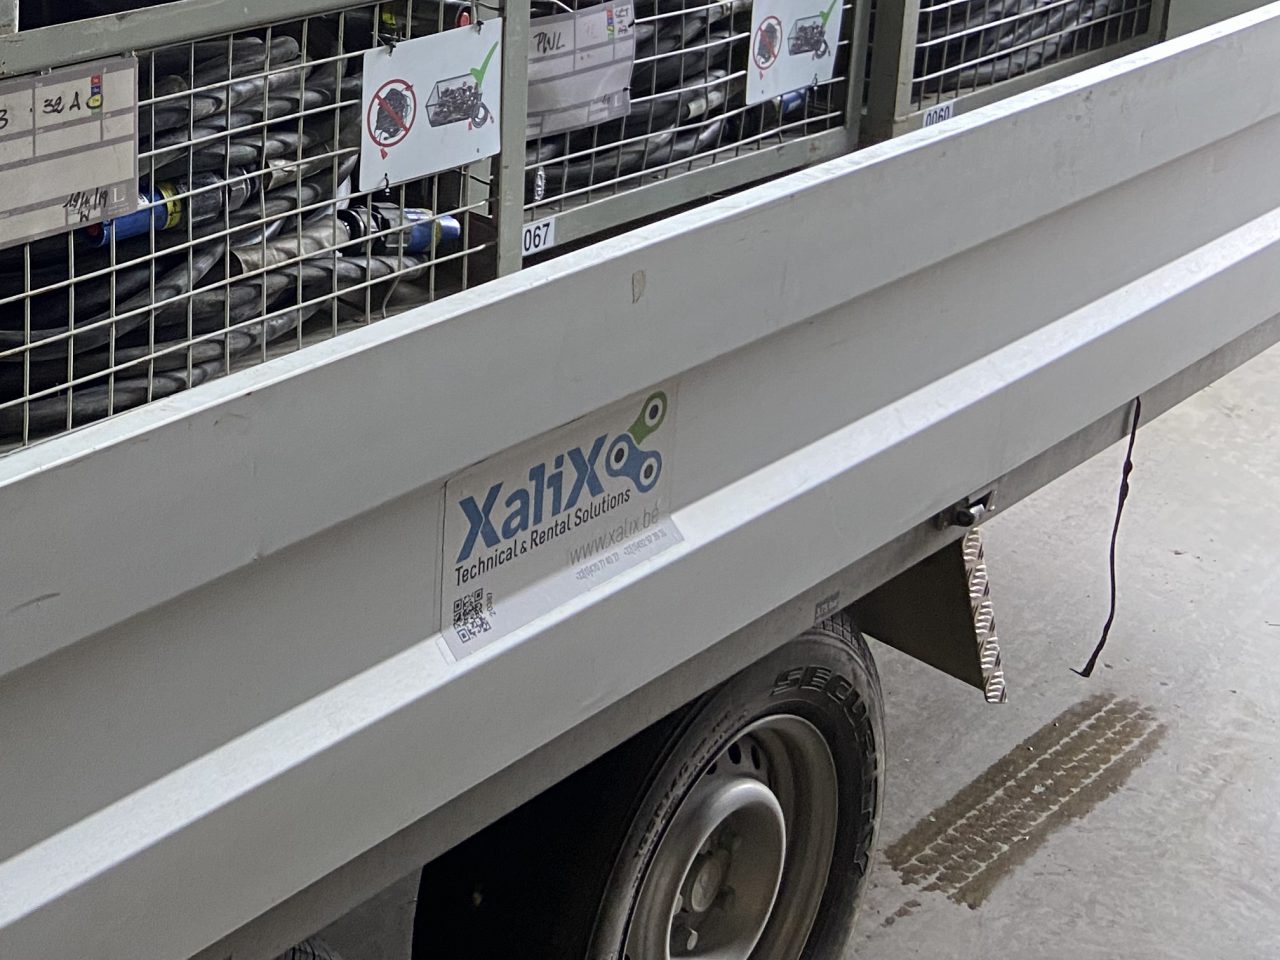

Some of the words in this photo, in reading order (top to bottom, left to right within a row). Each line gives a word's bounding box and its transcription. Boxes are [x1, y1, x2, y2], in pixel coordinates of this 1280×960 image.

[42, 95, 66, 114] 32
[69, 91, 81, 112] A
[925, 105, 950, 127] 0060
[455, 540, 518, 586] Technical
[520, 541, 528, 554] &
[529, 514, 571, 548] Rental
[574, 488, 631, 527] Solutions
[569, 504, 660, 566] www.xalix.be
